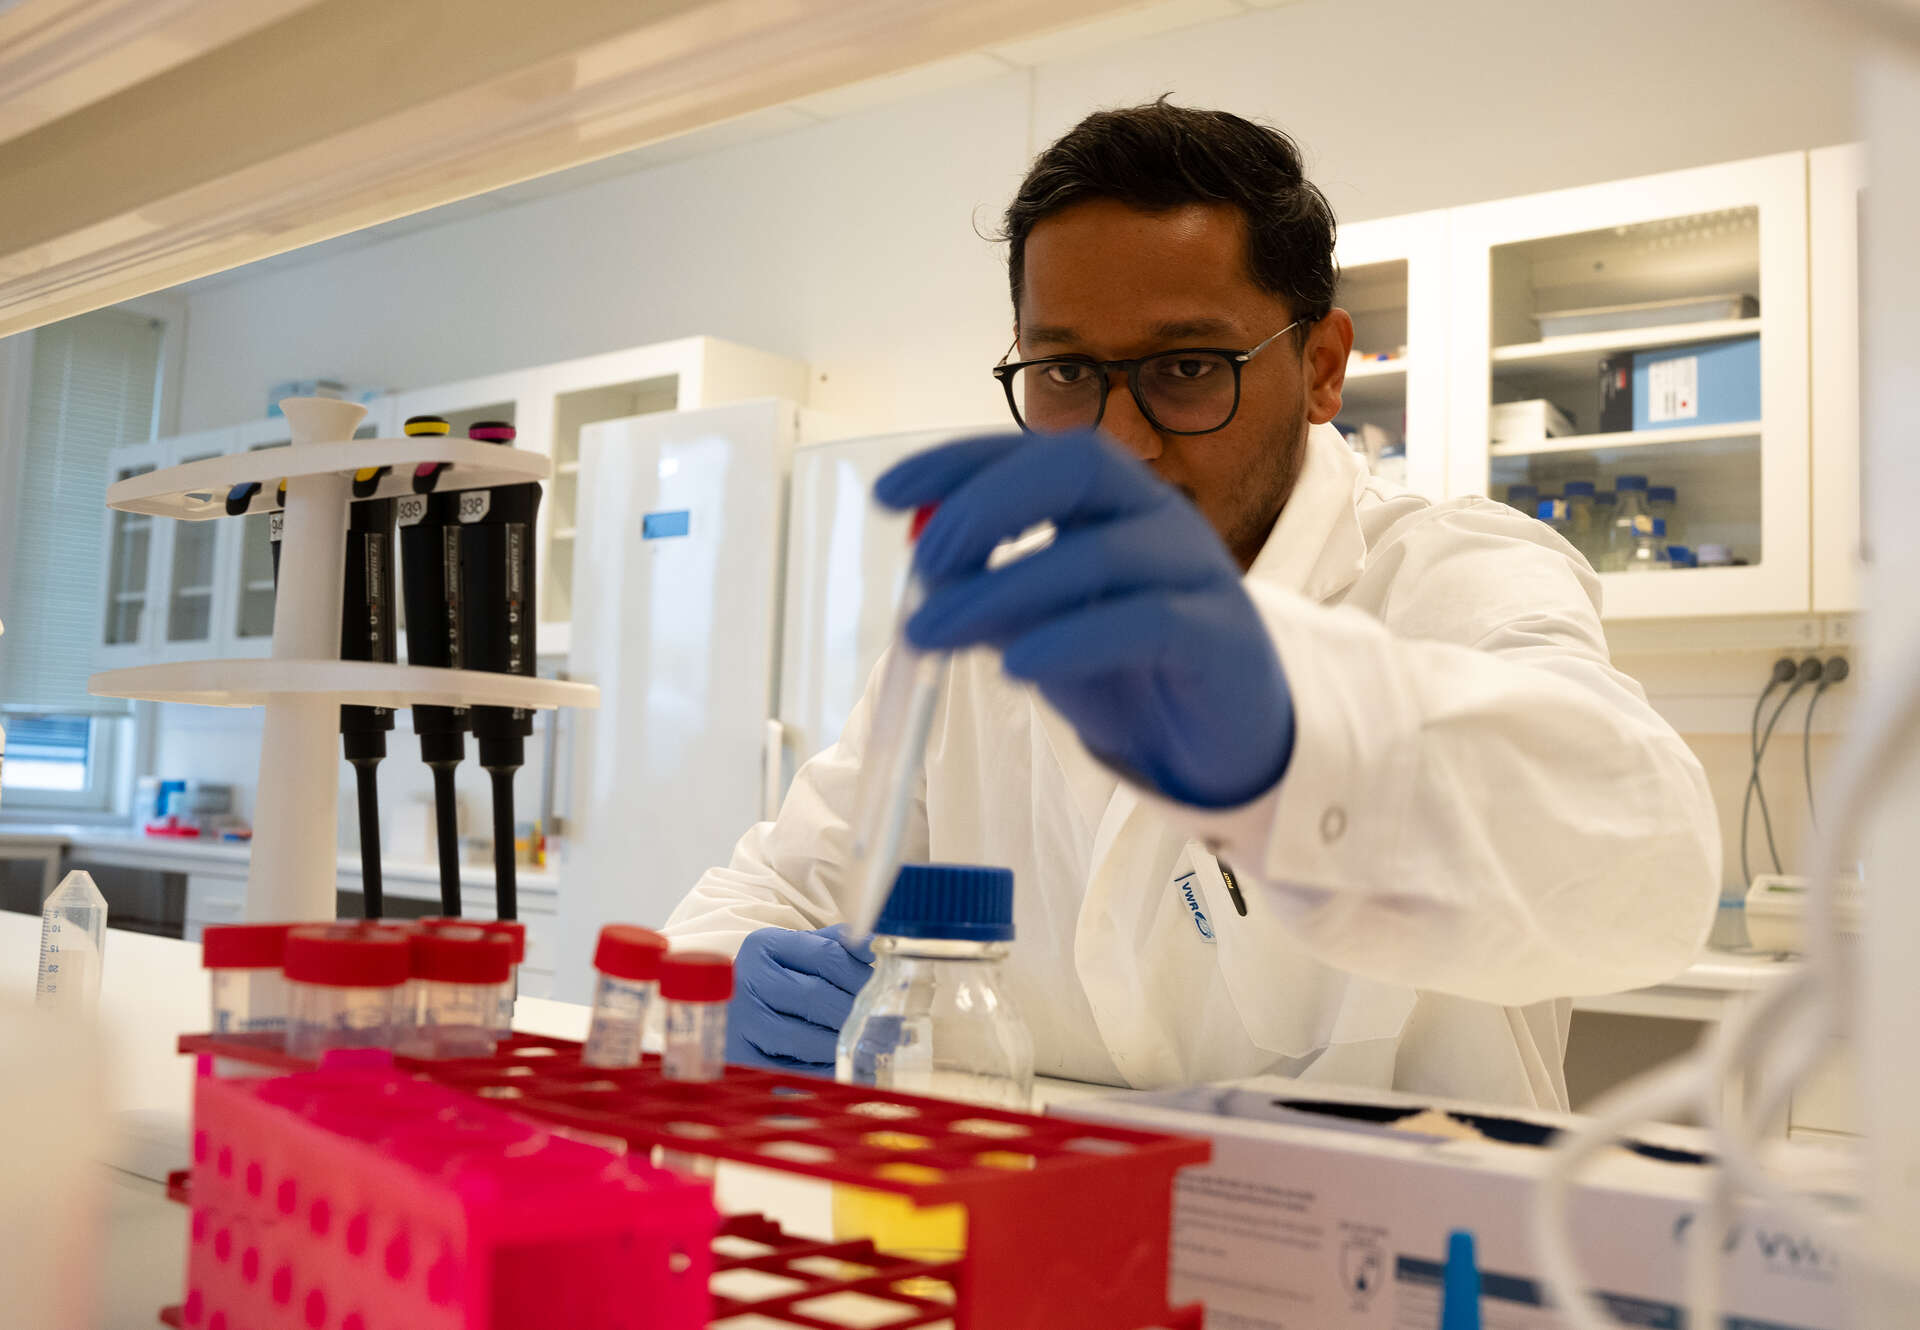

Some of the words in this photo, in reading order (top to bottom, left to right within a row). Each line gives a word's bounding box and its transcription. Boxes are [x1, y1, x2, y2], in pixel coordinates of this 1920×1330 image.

[1182, 881, 1199, 911] VWR
[52, 925, 61, 933] 10
[50, 944, 59, 952] 15
